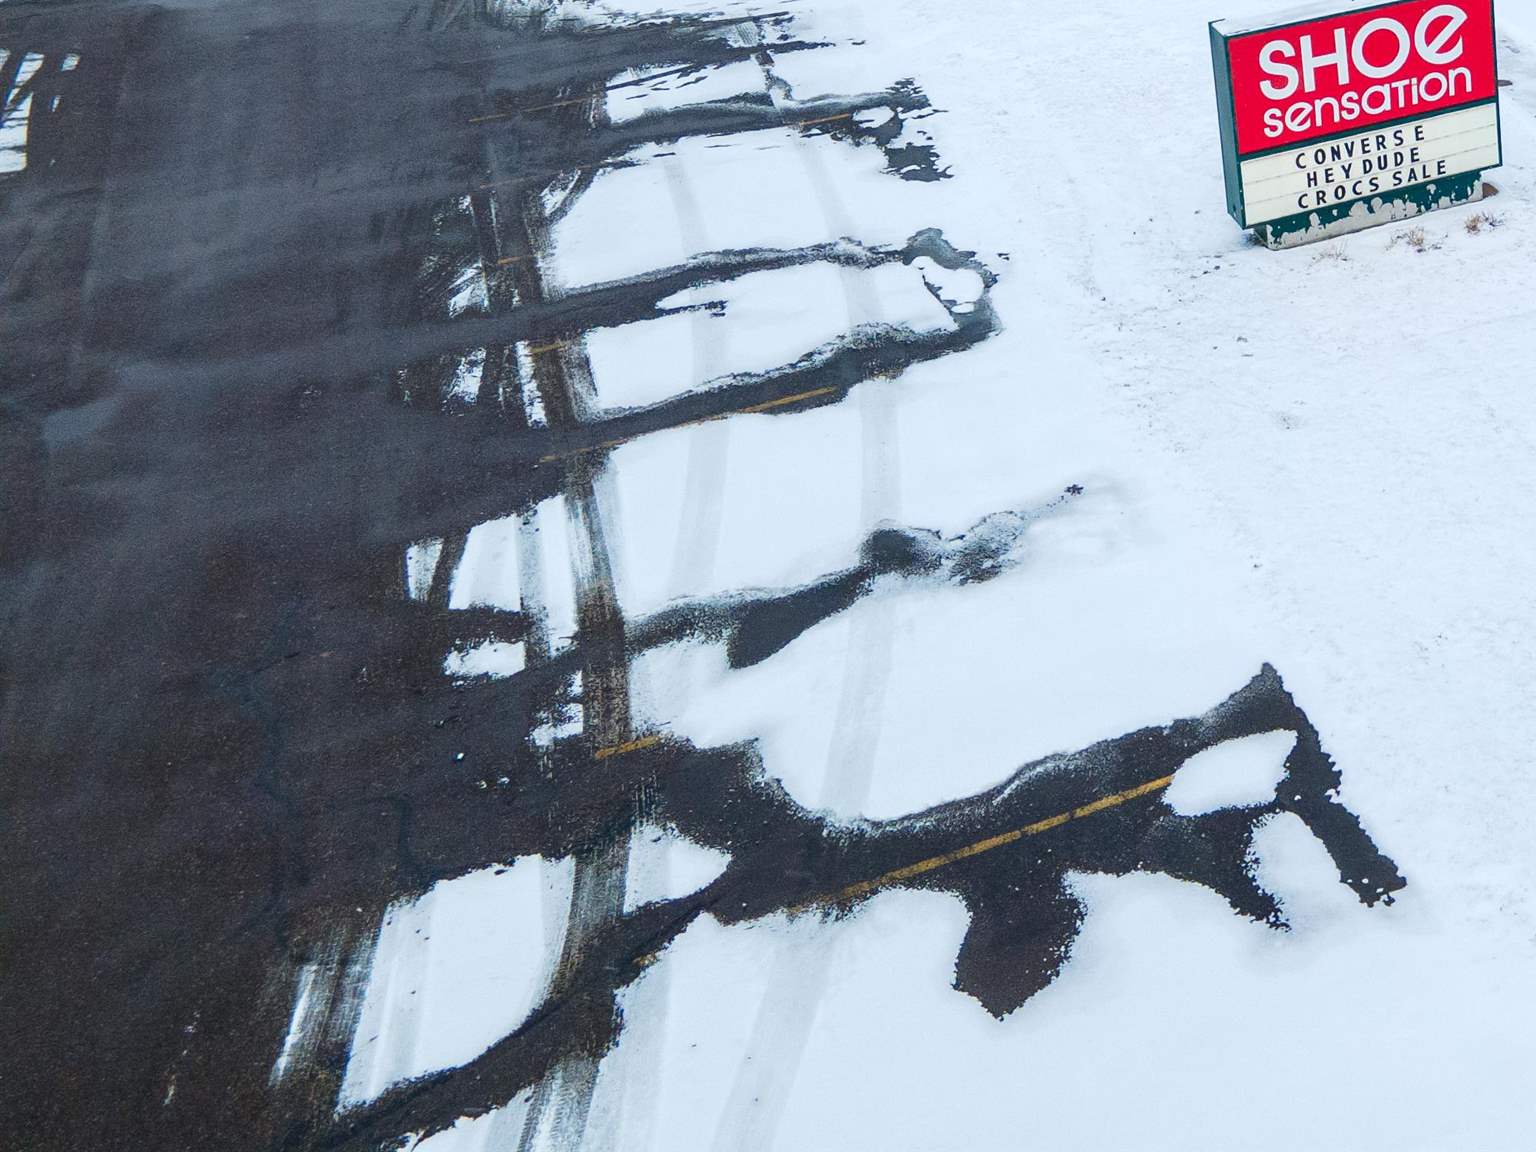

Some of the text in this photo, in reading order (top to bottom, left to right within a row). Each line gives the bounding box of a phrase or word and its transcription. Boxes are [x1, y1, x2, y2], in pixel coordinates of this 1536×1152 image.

[1258, 4, 1468, 100] SHOE
[1263, 66, 1473, 138] sensation
[1296, 125, 1425, 169] CONVERSE
[1307, 147, 1421, 188] HEY DUDE
[1297, 160, 1447, 209] CROCS SALE
